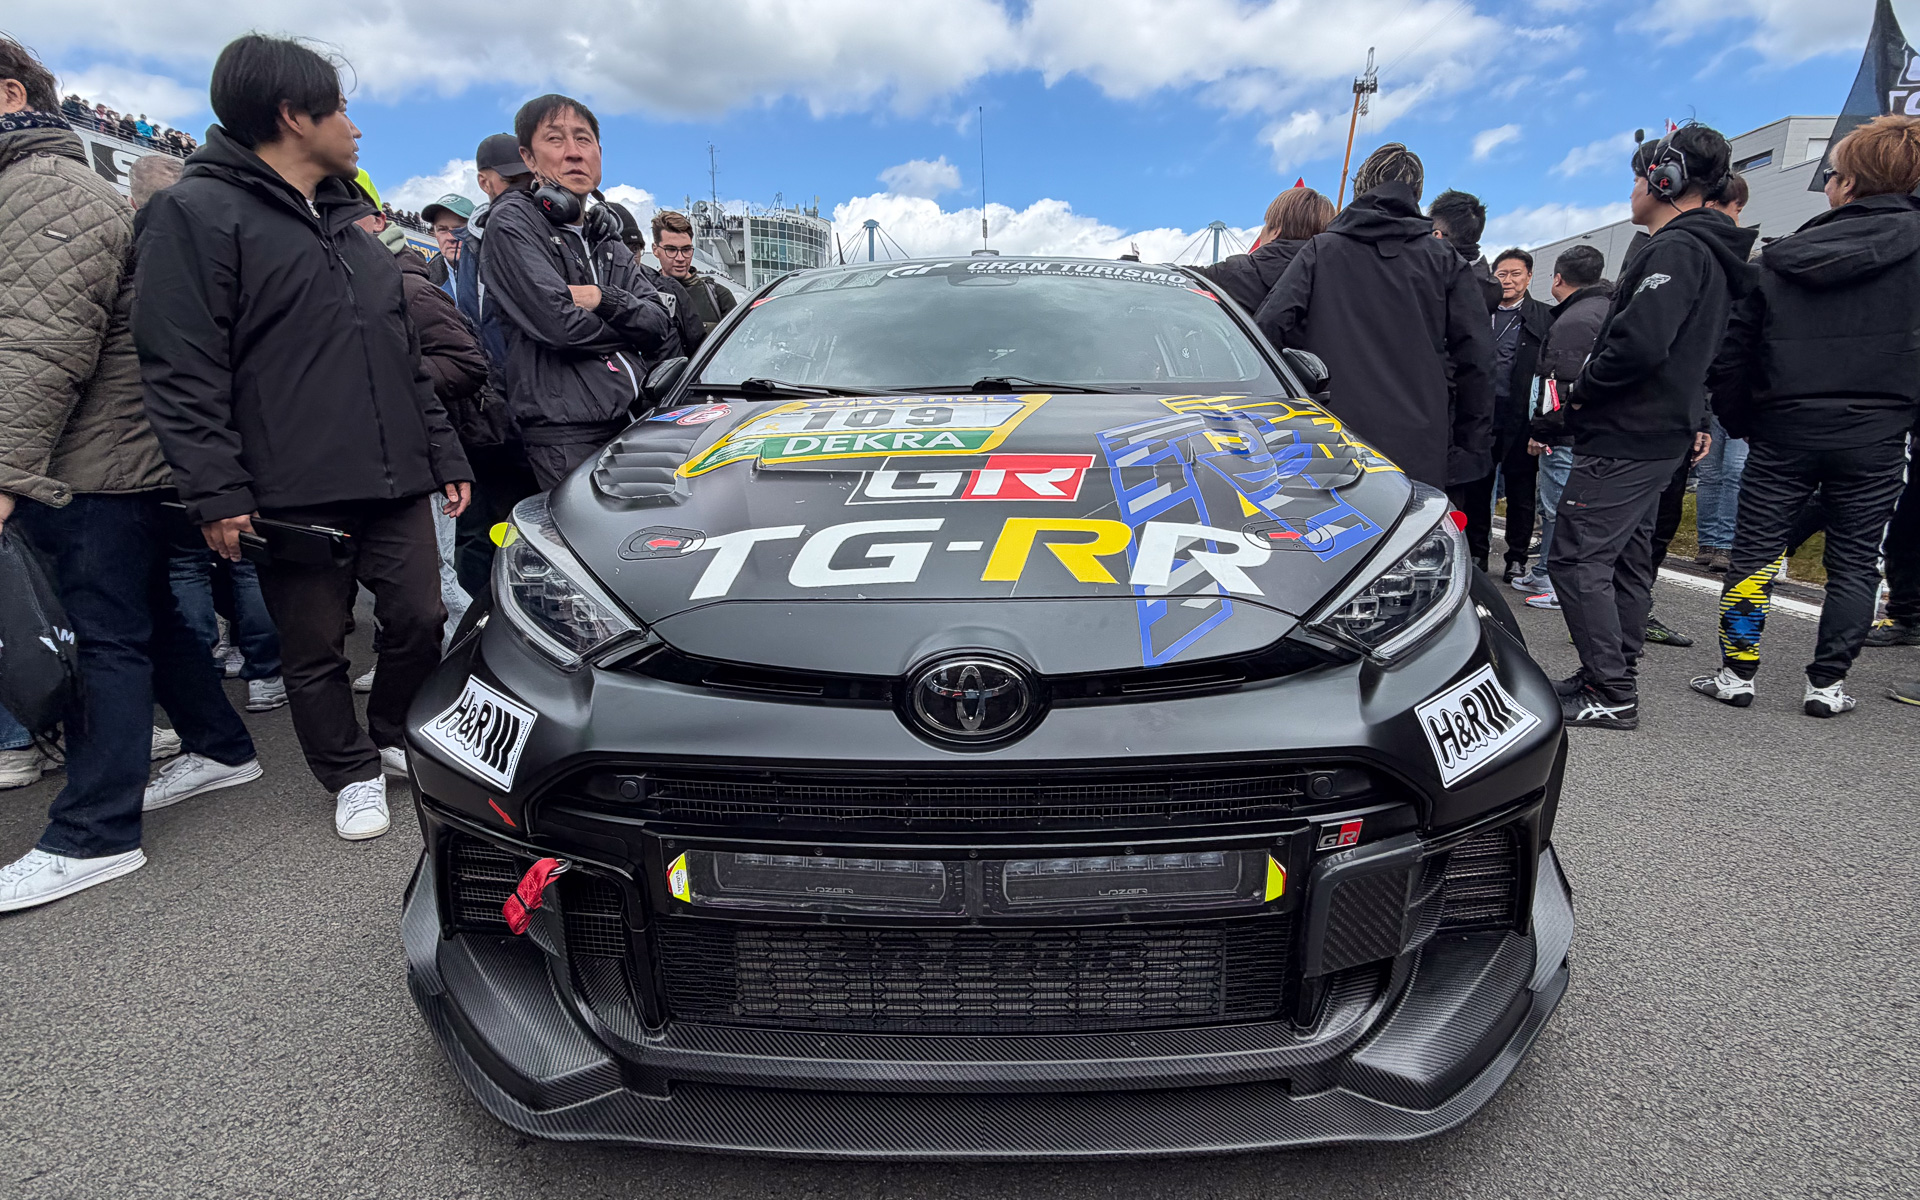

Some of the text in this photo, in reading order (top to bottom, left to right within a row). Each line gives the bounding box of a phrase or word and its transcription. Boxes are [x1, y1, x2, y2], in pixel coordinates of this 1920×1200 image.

[967, 262, 1188, 284] GRAN TURISMO
[1042, 270, 1101, 278] DRIVING
[1104, 274, 1188, 289] SIMULATOR
[818, 395, 1008, 408] RAVENOL
[802, 406, 954, 431] 109
[782, 431, 966, 455] DEKRA
[862, 467, 1078, 498] GR
[681, 517, 1272, 600] TG-RR
[1320, 830, 1358, 848] GR
[805, 886, 854, 895] LAZER
[1098, 888, 1148, 896] LAZER
